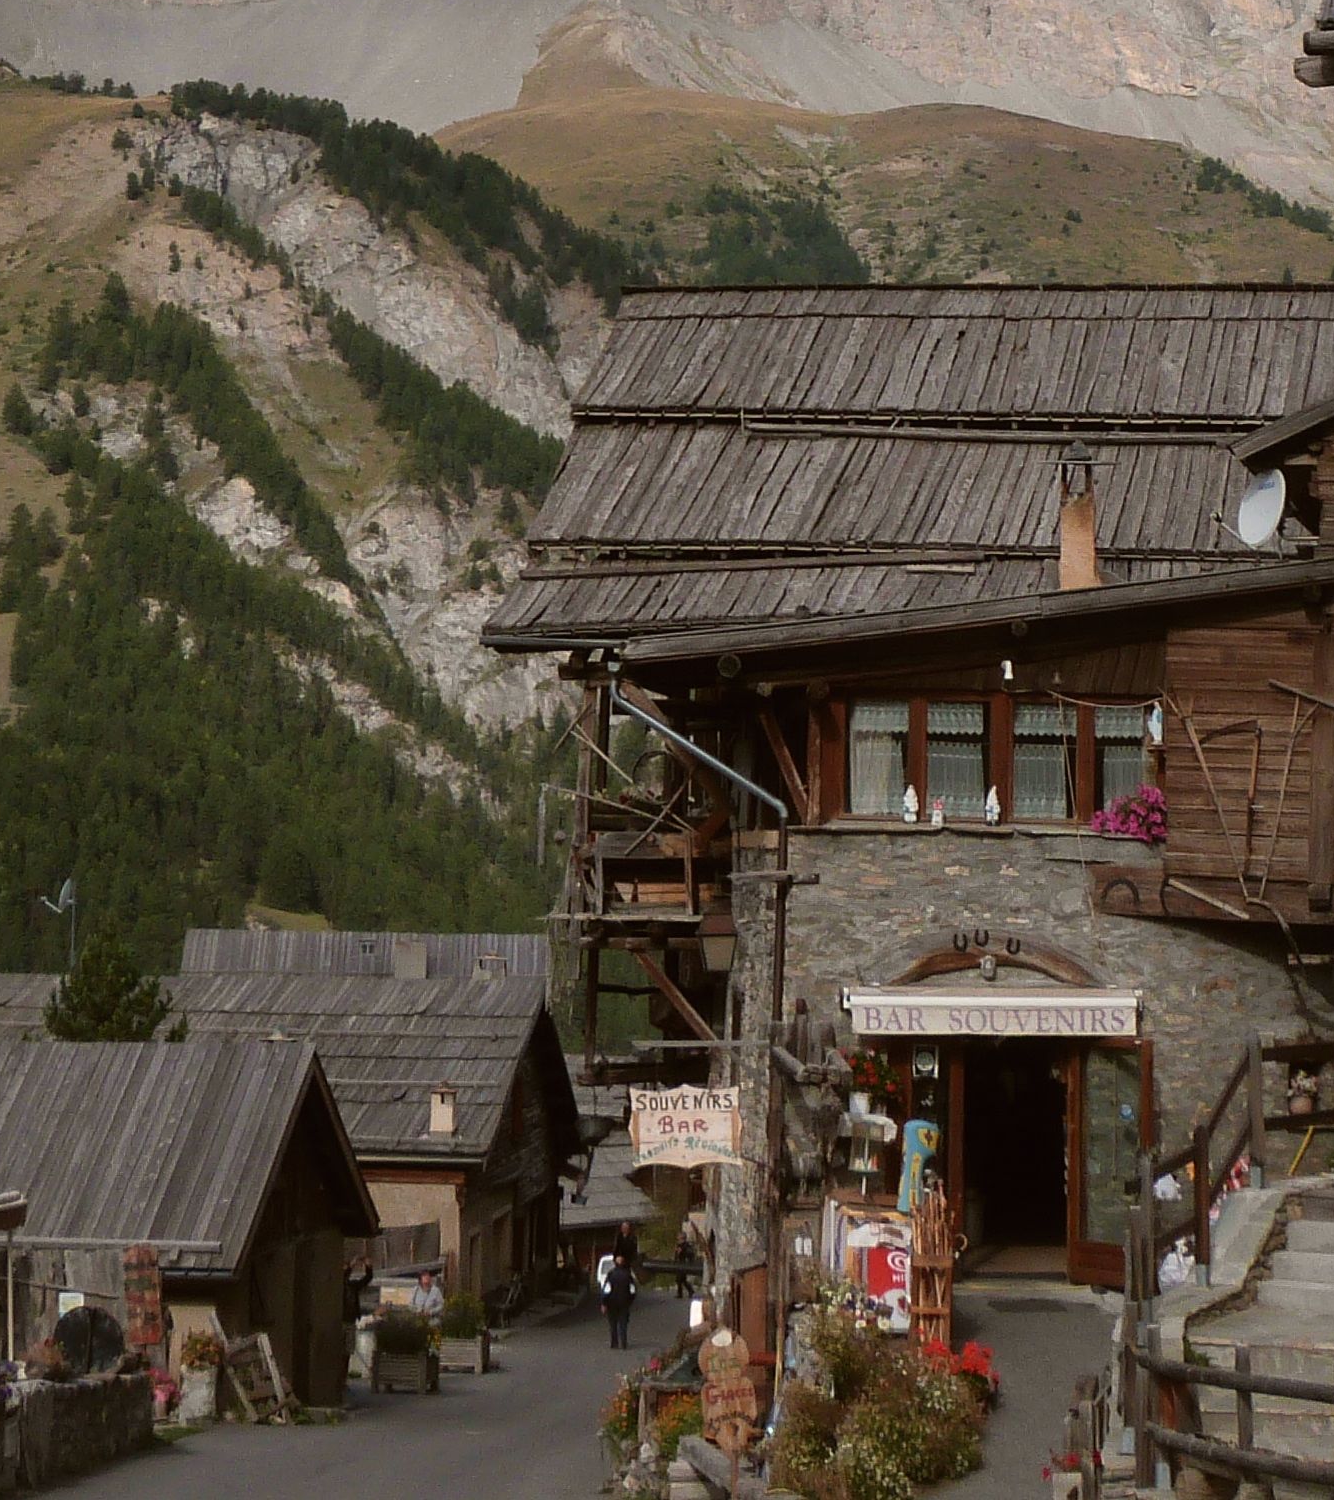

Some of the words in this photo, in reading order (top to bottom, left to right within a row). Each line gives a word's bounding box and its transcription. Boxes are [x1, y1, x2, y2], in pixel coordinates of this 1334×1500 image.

[863, 1007, 926, 1032] BAR
[947, 1007, 1127, 1033] SOUVENIRS
[635, 1090, 734, 1112] SOUVENIRS
